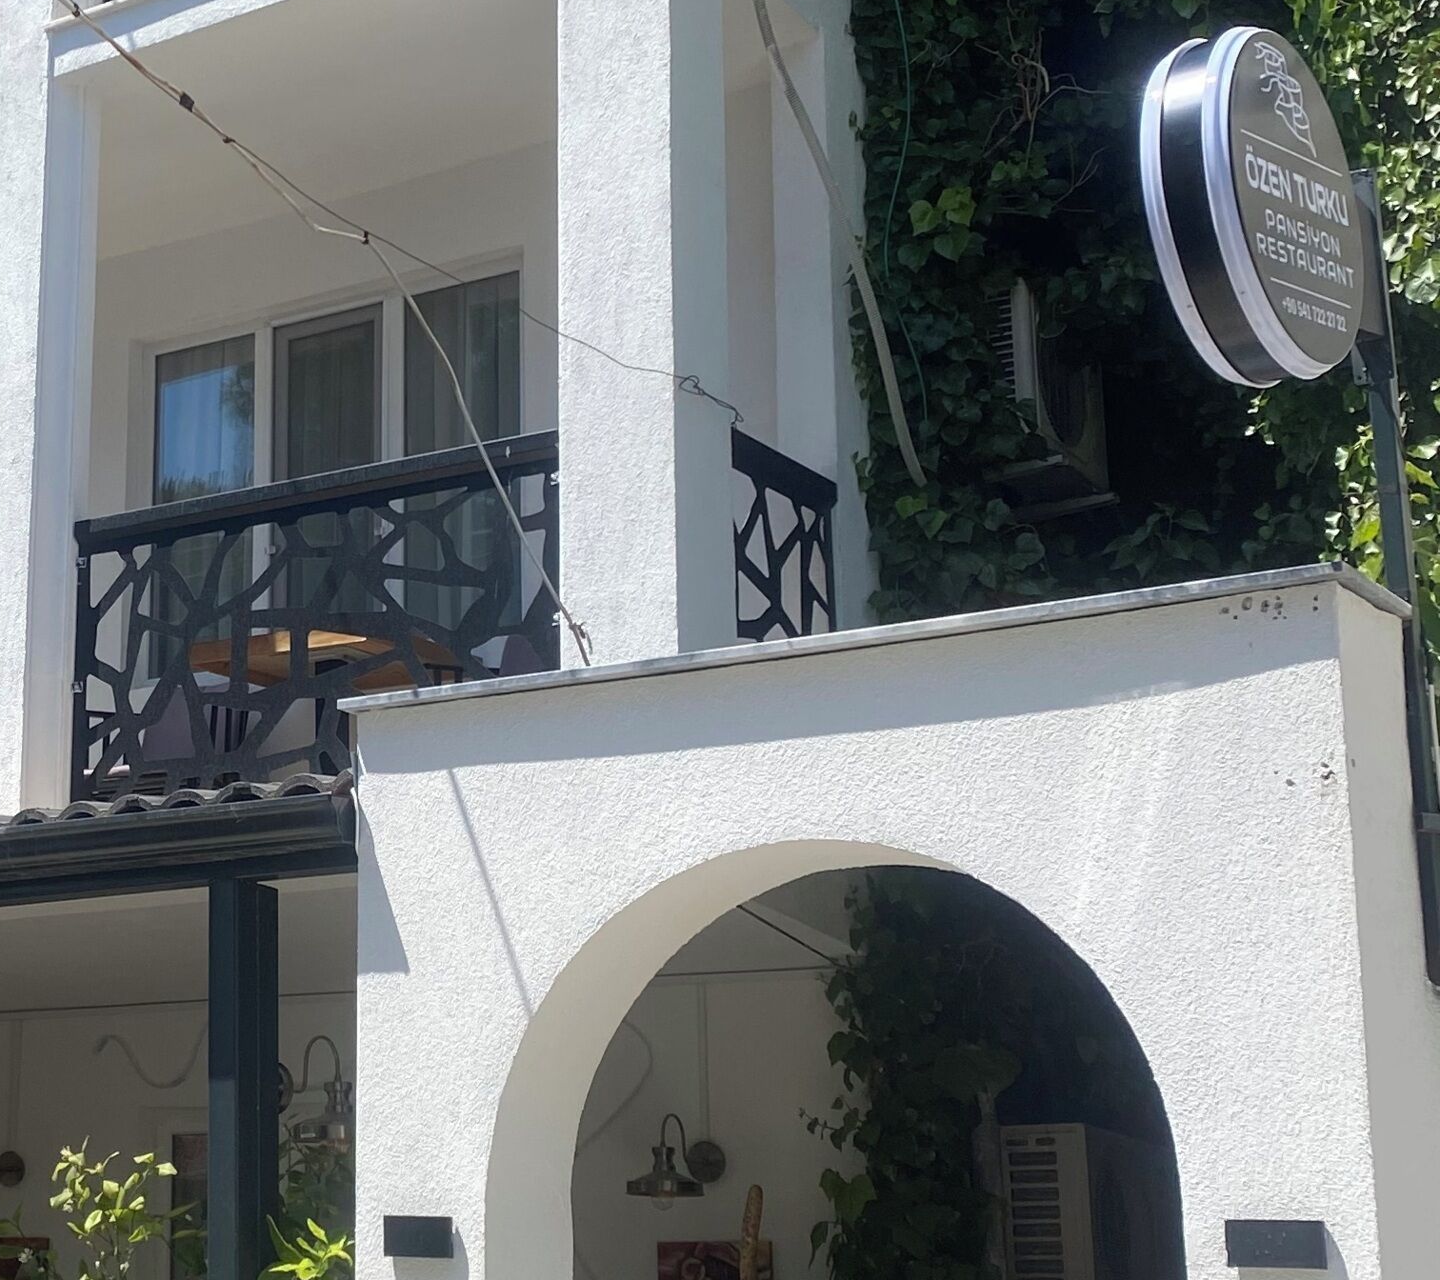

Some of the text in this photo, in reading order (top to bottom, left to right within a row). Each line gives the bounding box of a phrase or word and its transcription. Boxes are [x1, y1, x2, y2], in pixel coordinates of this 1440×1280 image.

[1245, 144, 1349, 226] ÖZEN TURKU
[1265, 208, 1341, 257] PANSİYON
[1256, 232, 1354, 288] RESTAURANT
[1311, 305, 1326, 325] 722
[1326, 311, 1336, 328] 27
[1336, 314, 1347, 332] 22
